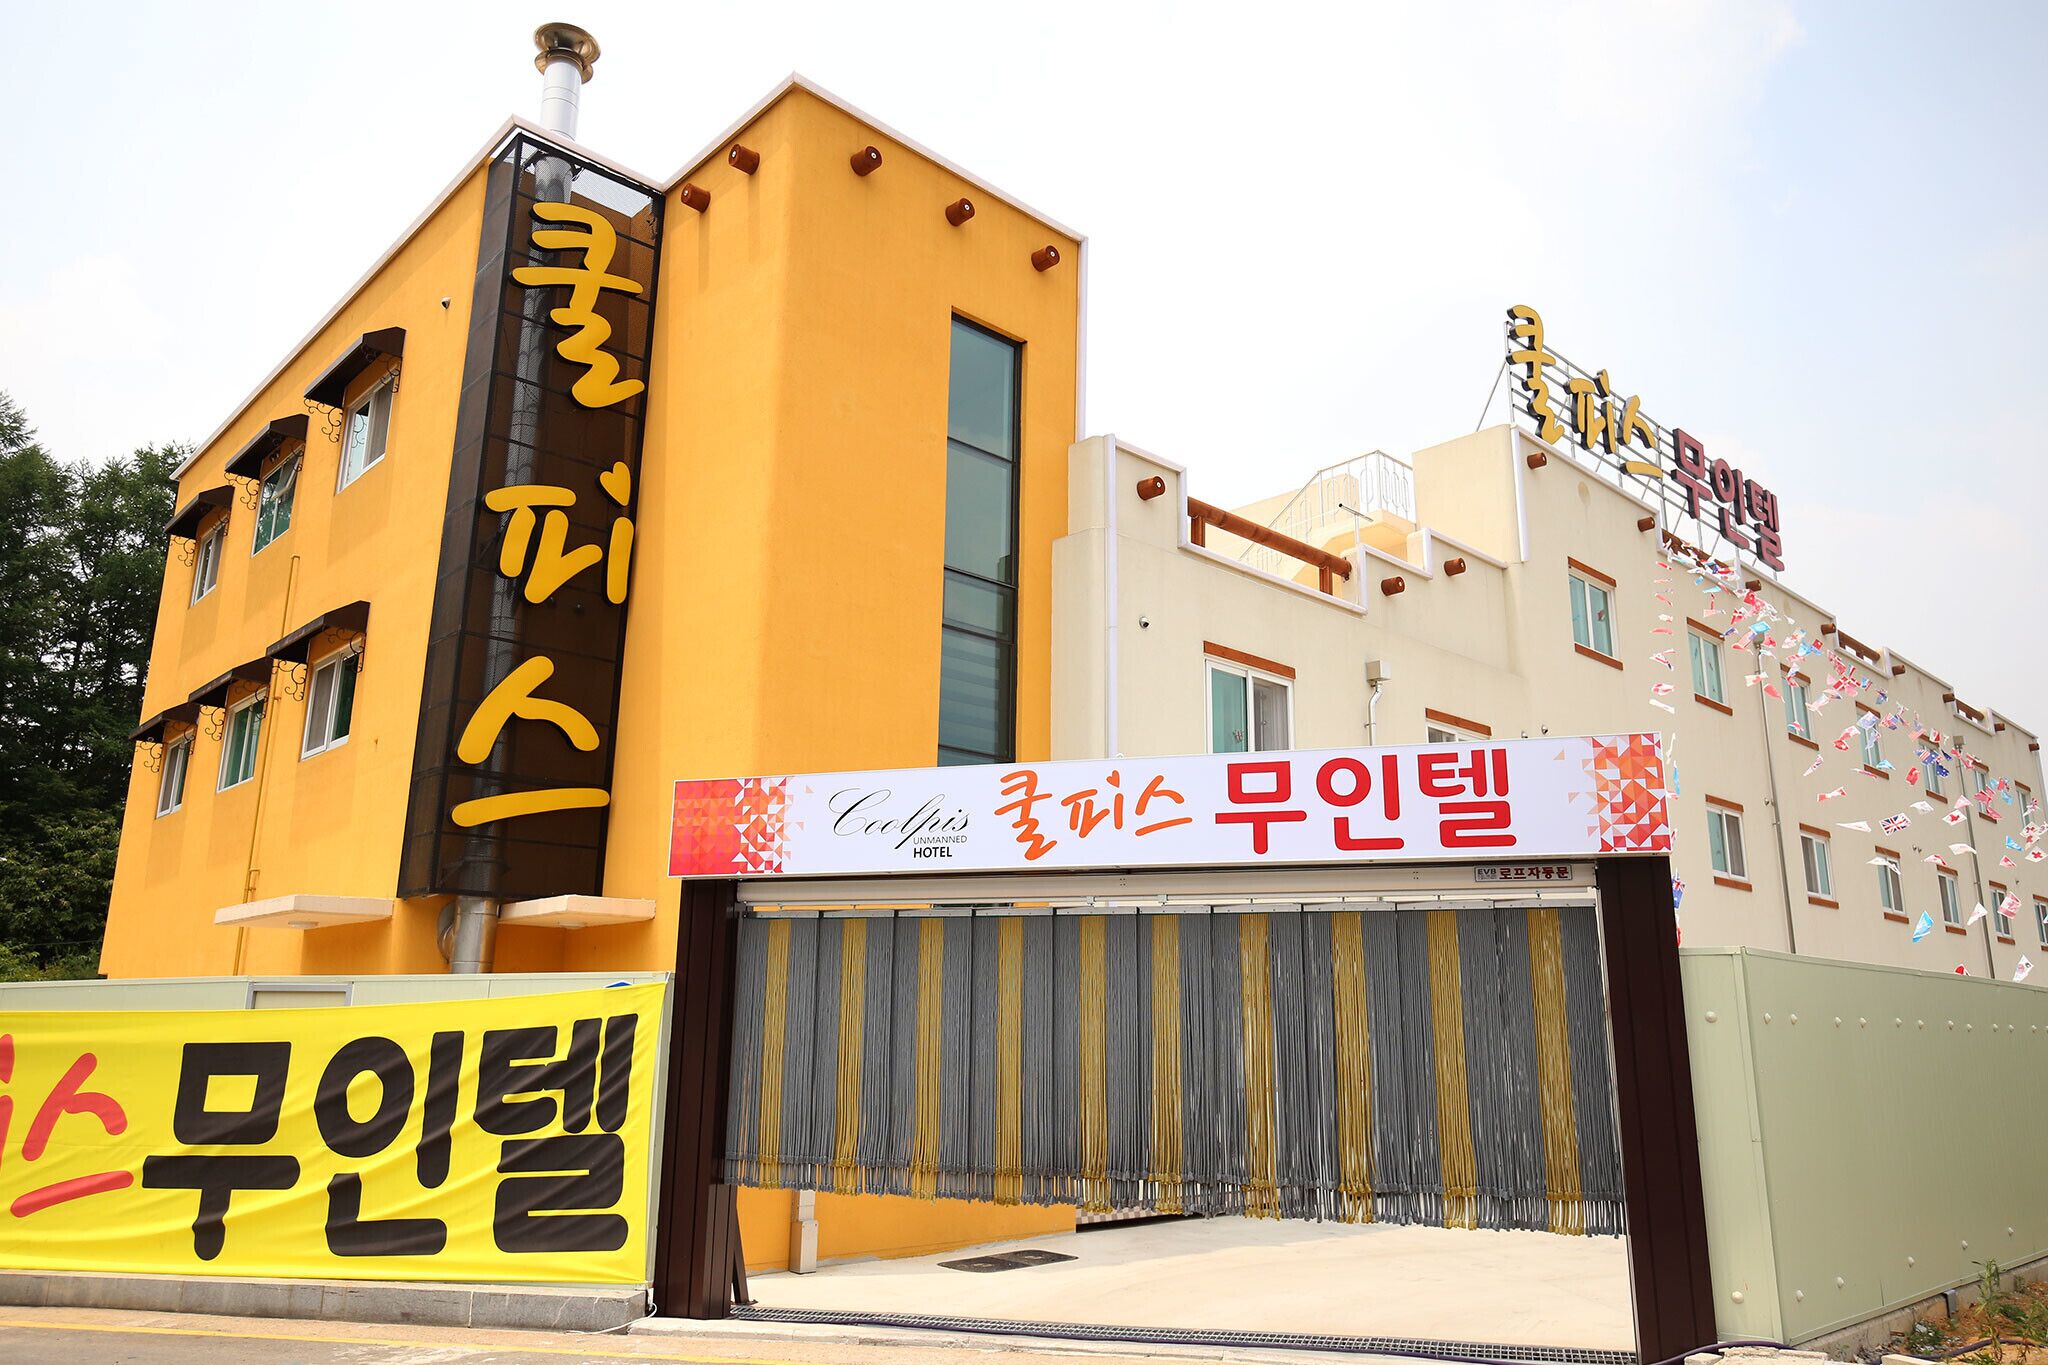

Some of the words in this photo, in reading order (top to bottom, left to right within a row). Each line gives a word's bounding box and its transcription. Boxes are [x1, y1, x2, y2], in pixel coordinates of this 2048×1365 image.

[1506, 304, 1664, 479] 쿨피스
[1671, 428, 1785, 572] 무인텔
[451, 202, 645, 827] 쿨피스
[829, 788, 969, 849] Coolpis
[913, 835, 968, 845] UNMANNED
[994, 770, 1193, 861] 쿨피스
[1215, 748, 1517, 855] 무인텔
[913, 846, 953, 859] HOTEL
[1499, 866, 1569, 880] 로프자동문
[0, 1033, 134, 1218] 스
[142, 1013, 639, 1261] 무인텔
